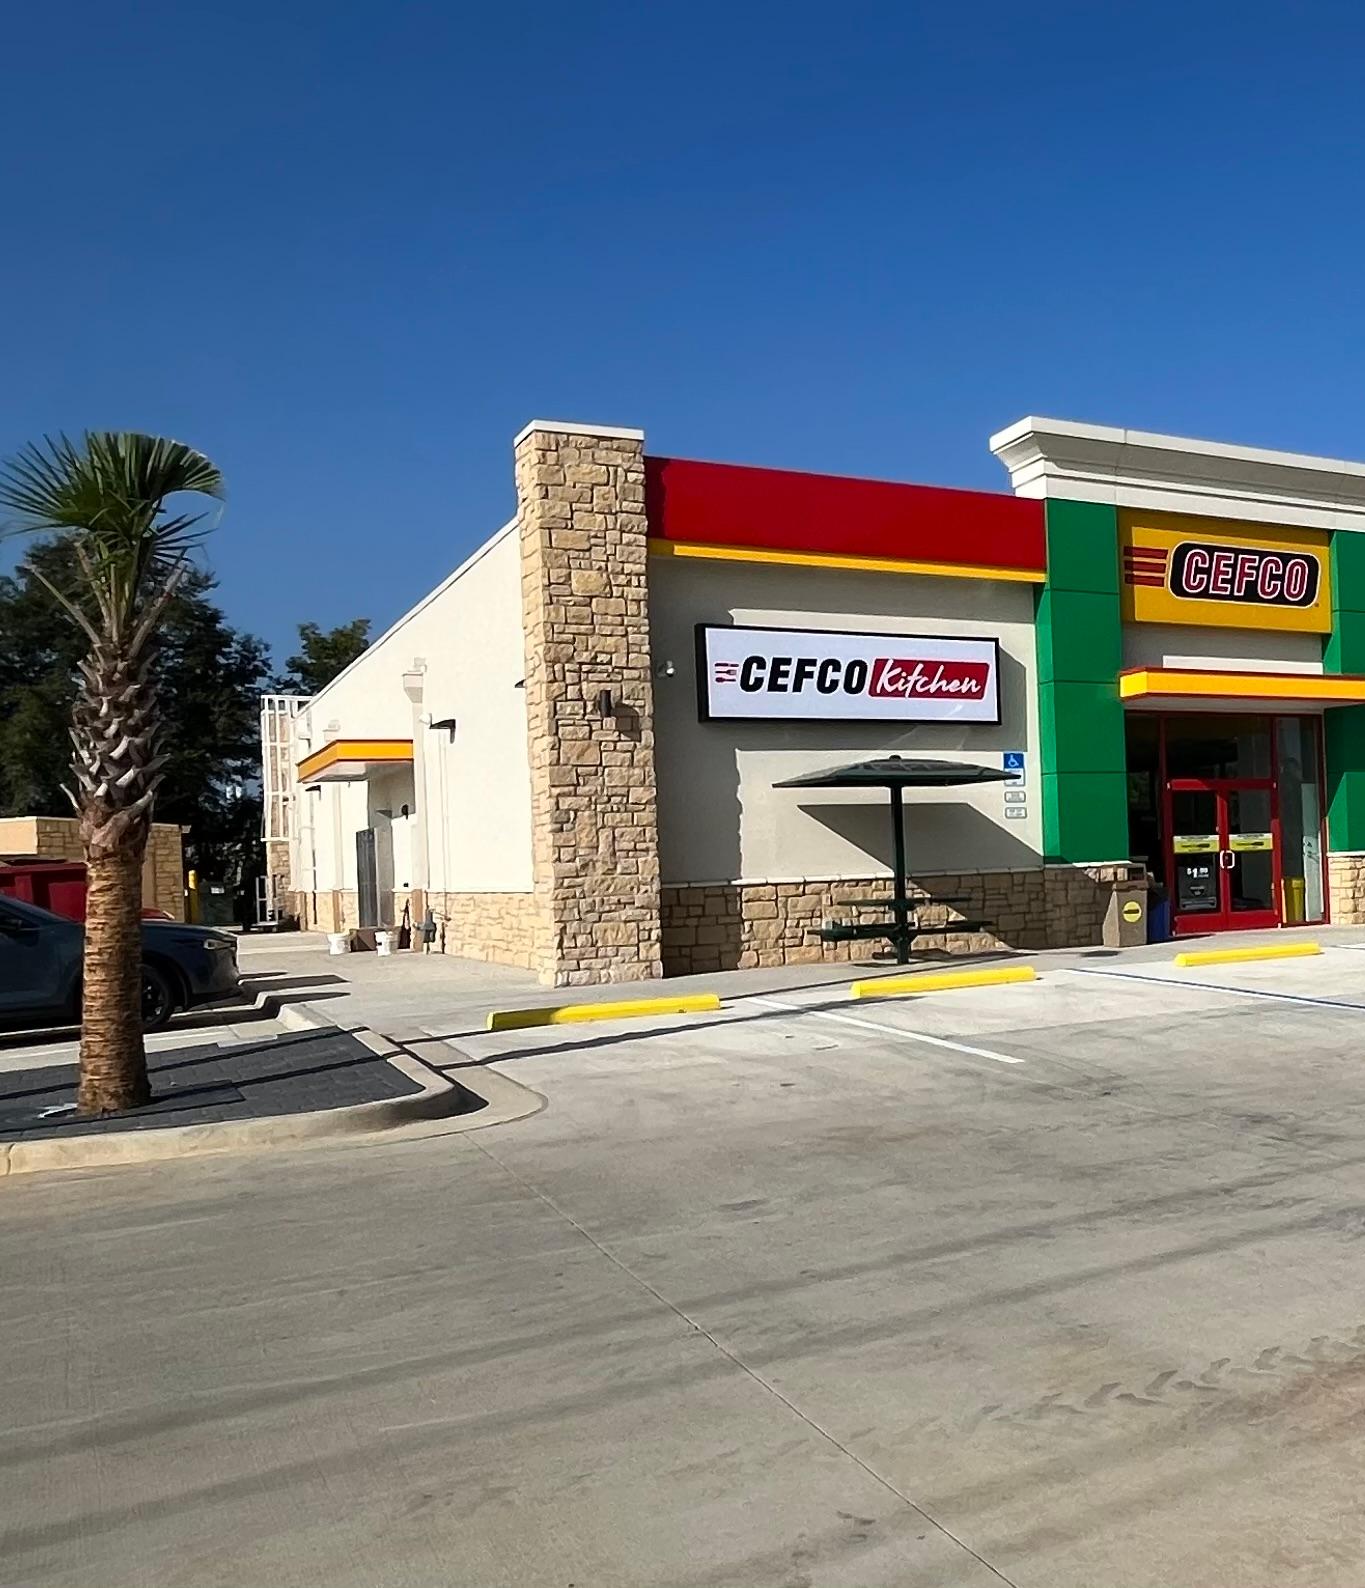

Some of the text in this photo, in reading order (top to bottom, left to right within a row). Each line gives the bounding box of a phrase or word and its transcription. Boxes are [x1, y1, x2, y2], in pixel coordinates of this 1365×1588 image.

[1182, 549, 1309, 601] CEFCO
[739, 655, 982, 698] CEFCO Kitchen
